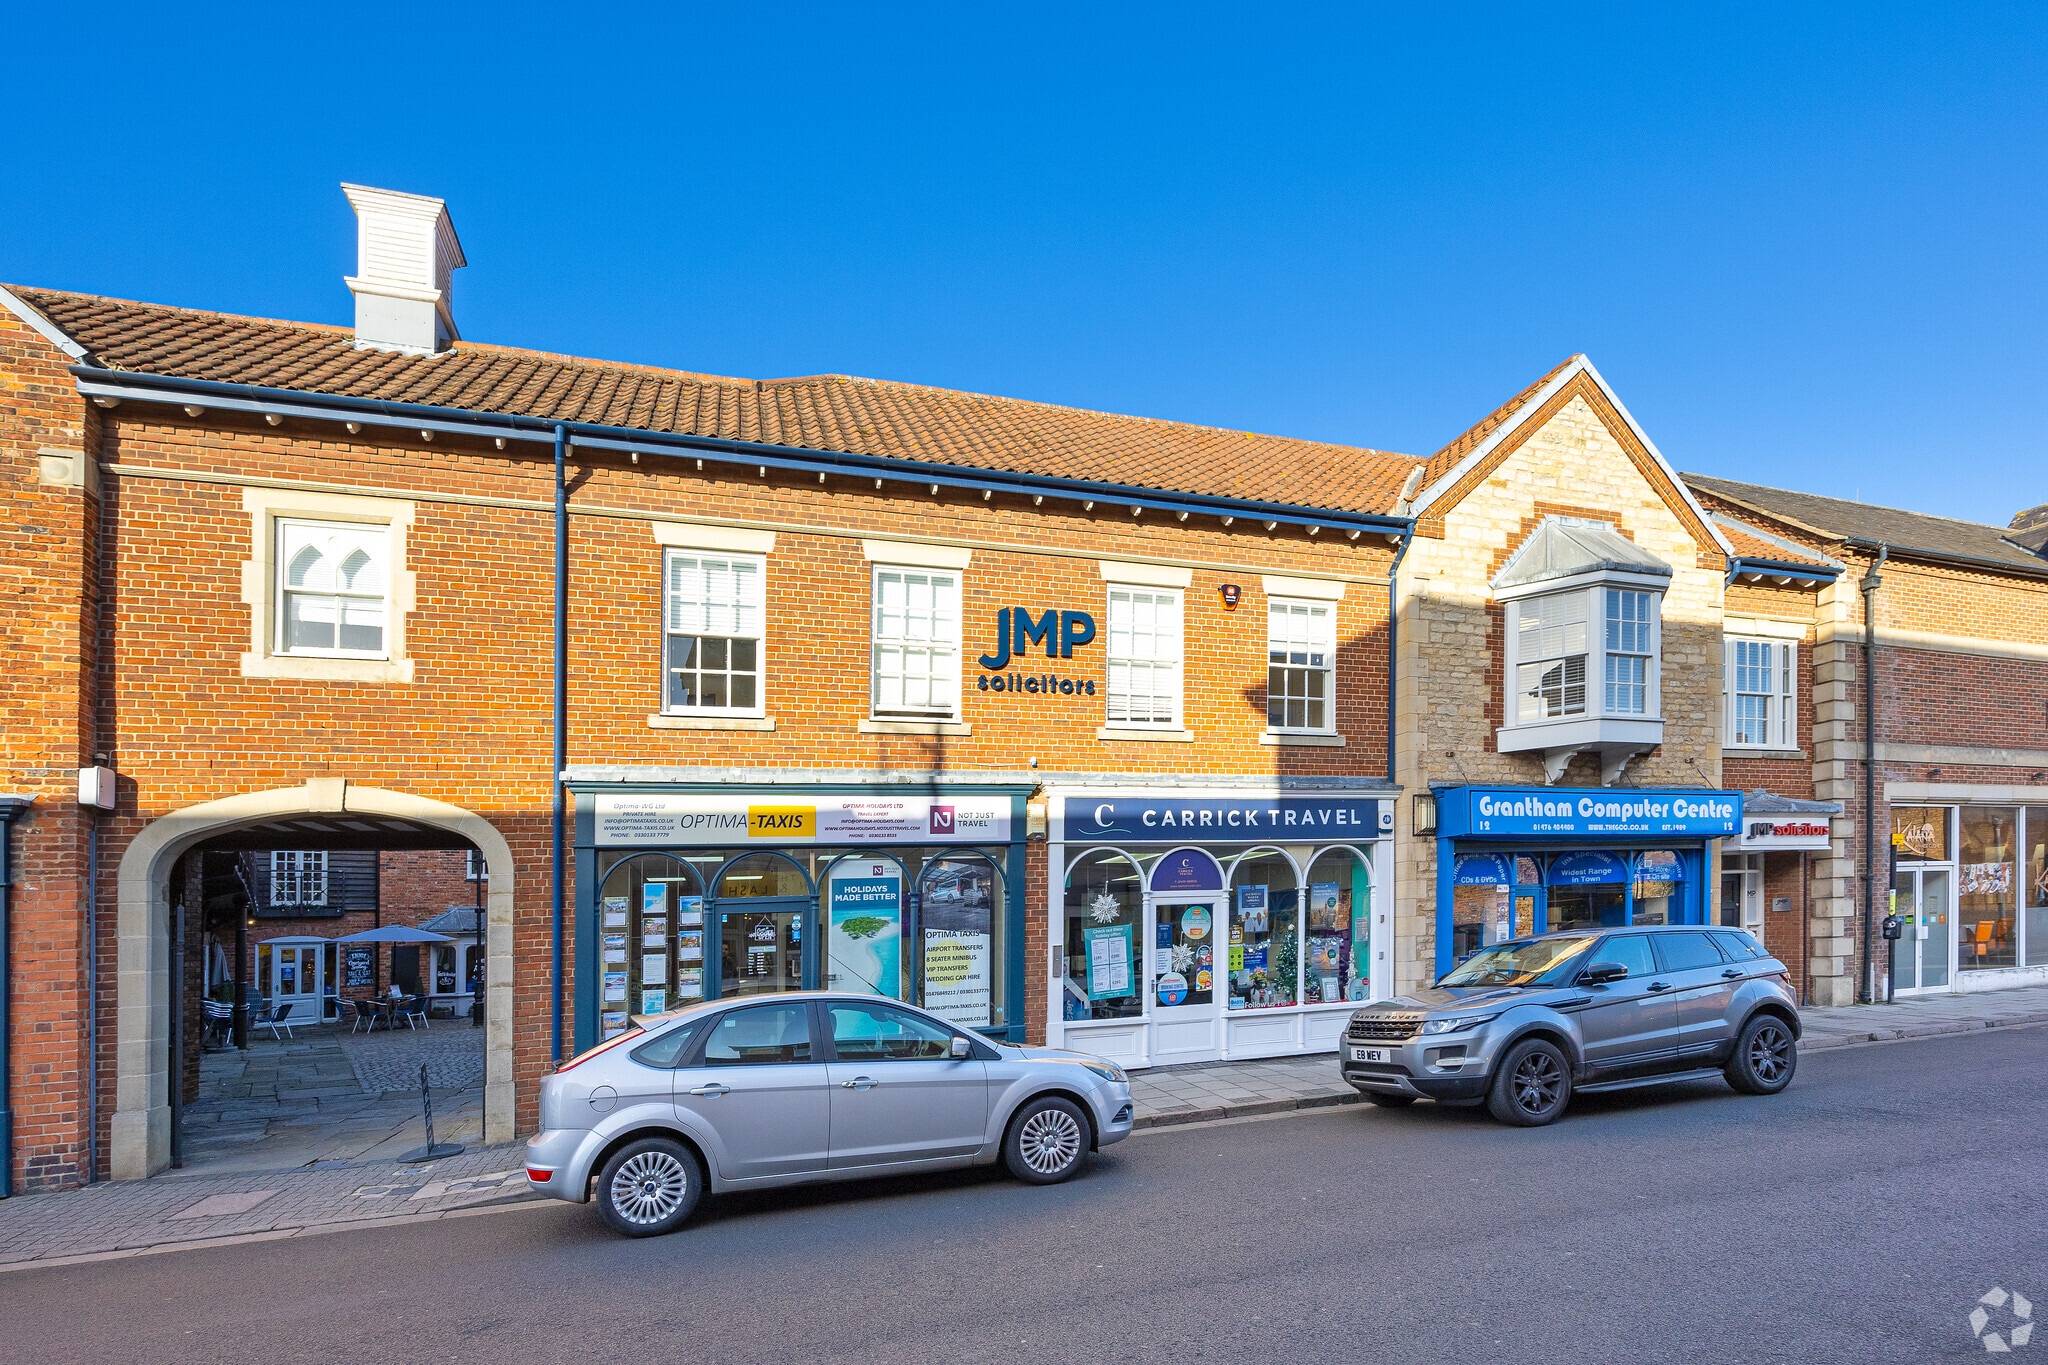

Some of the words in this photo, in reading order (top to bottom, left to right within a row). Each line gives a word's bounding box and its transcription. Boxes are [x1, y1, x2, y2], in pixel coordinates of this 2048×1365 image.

[978, 606, 1096, 670] JMP
[977, 672, 1095, 695] solicitors
[1479, 796, 1573, 817] Grantham
[1578, 797, 1669, 822] Computer
[1672, 798, 1733, 818] Centre
[1094, 804, 1114, 827] C
[1142, 809, 1259, 827] CARRICK
[1268, 809, 1361, 826] TRAVEL
[1479, 821, 1490, 830] 12
[1724, 822, 1733, 831] 12
[1746, 823, 1774, 839] JMP
[1774, 822, 1830, 836] solicitors
[1562, 856, 1573, 866] Ink
[1575, 851, 1611, 864] Specialist
[844, 885, 888, 893] HOLIDAYS
[835, 894, 861, 902] MADE
[863, 893, 896, 901] BETTER
[926, 931, 957, 939] OPTIMA
[926, 1003, 987, 1011] WWW.OPTIMA-TAXIS.CO.UK
[1356, 1050, 1366, 1060] E8
